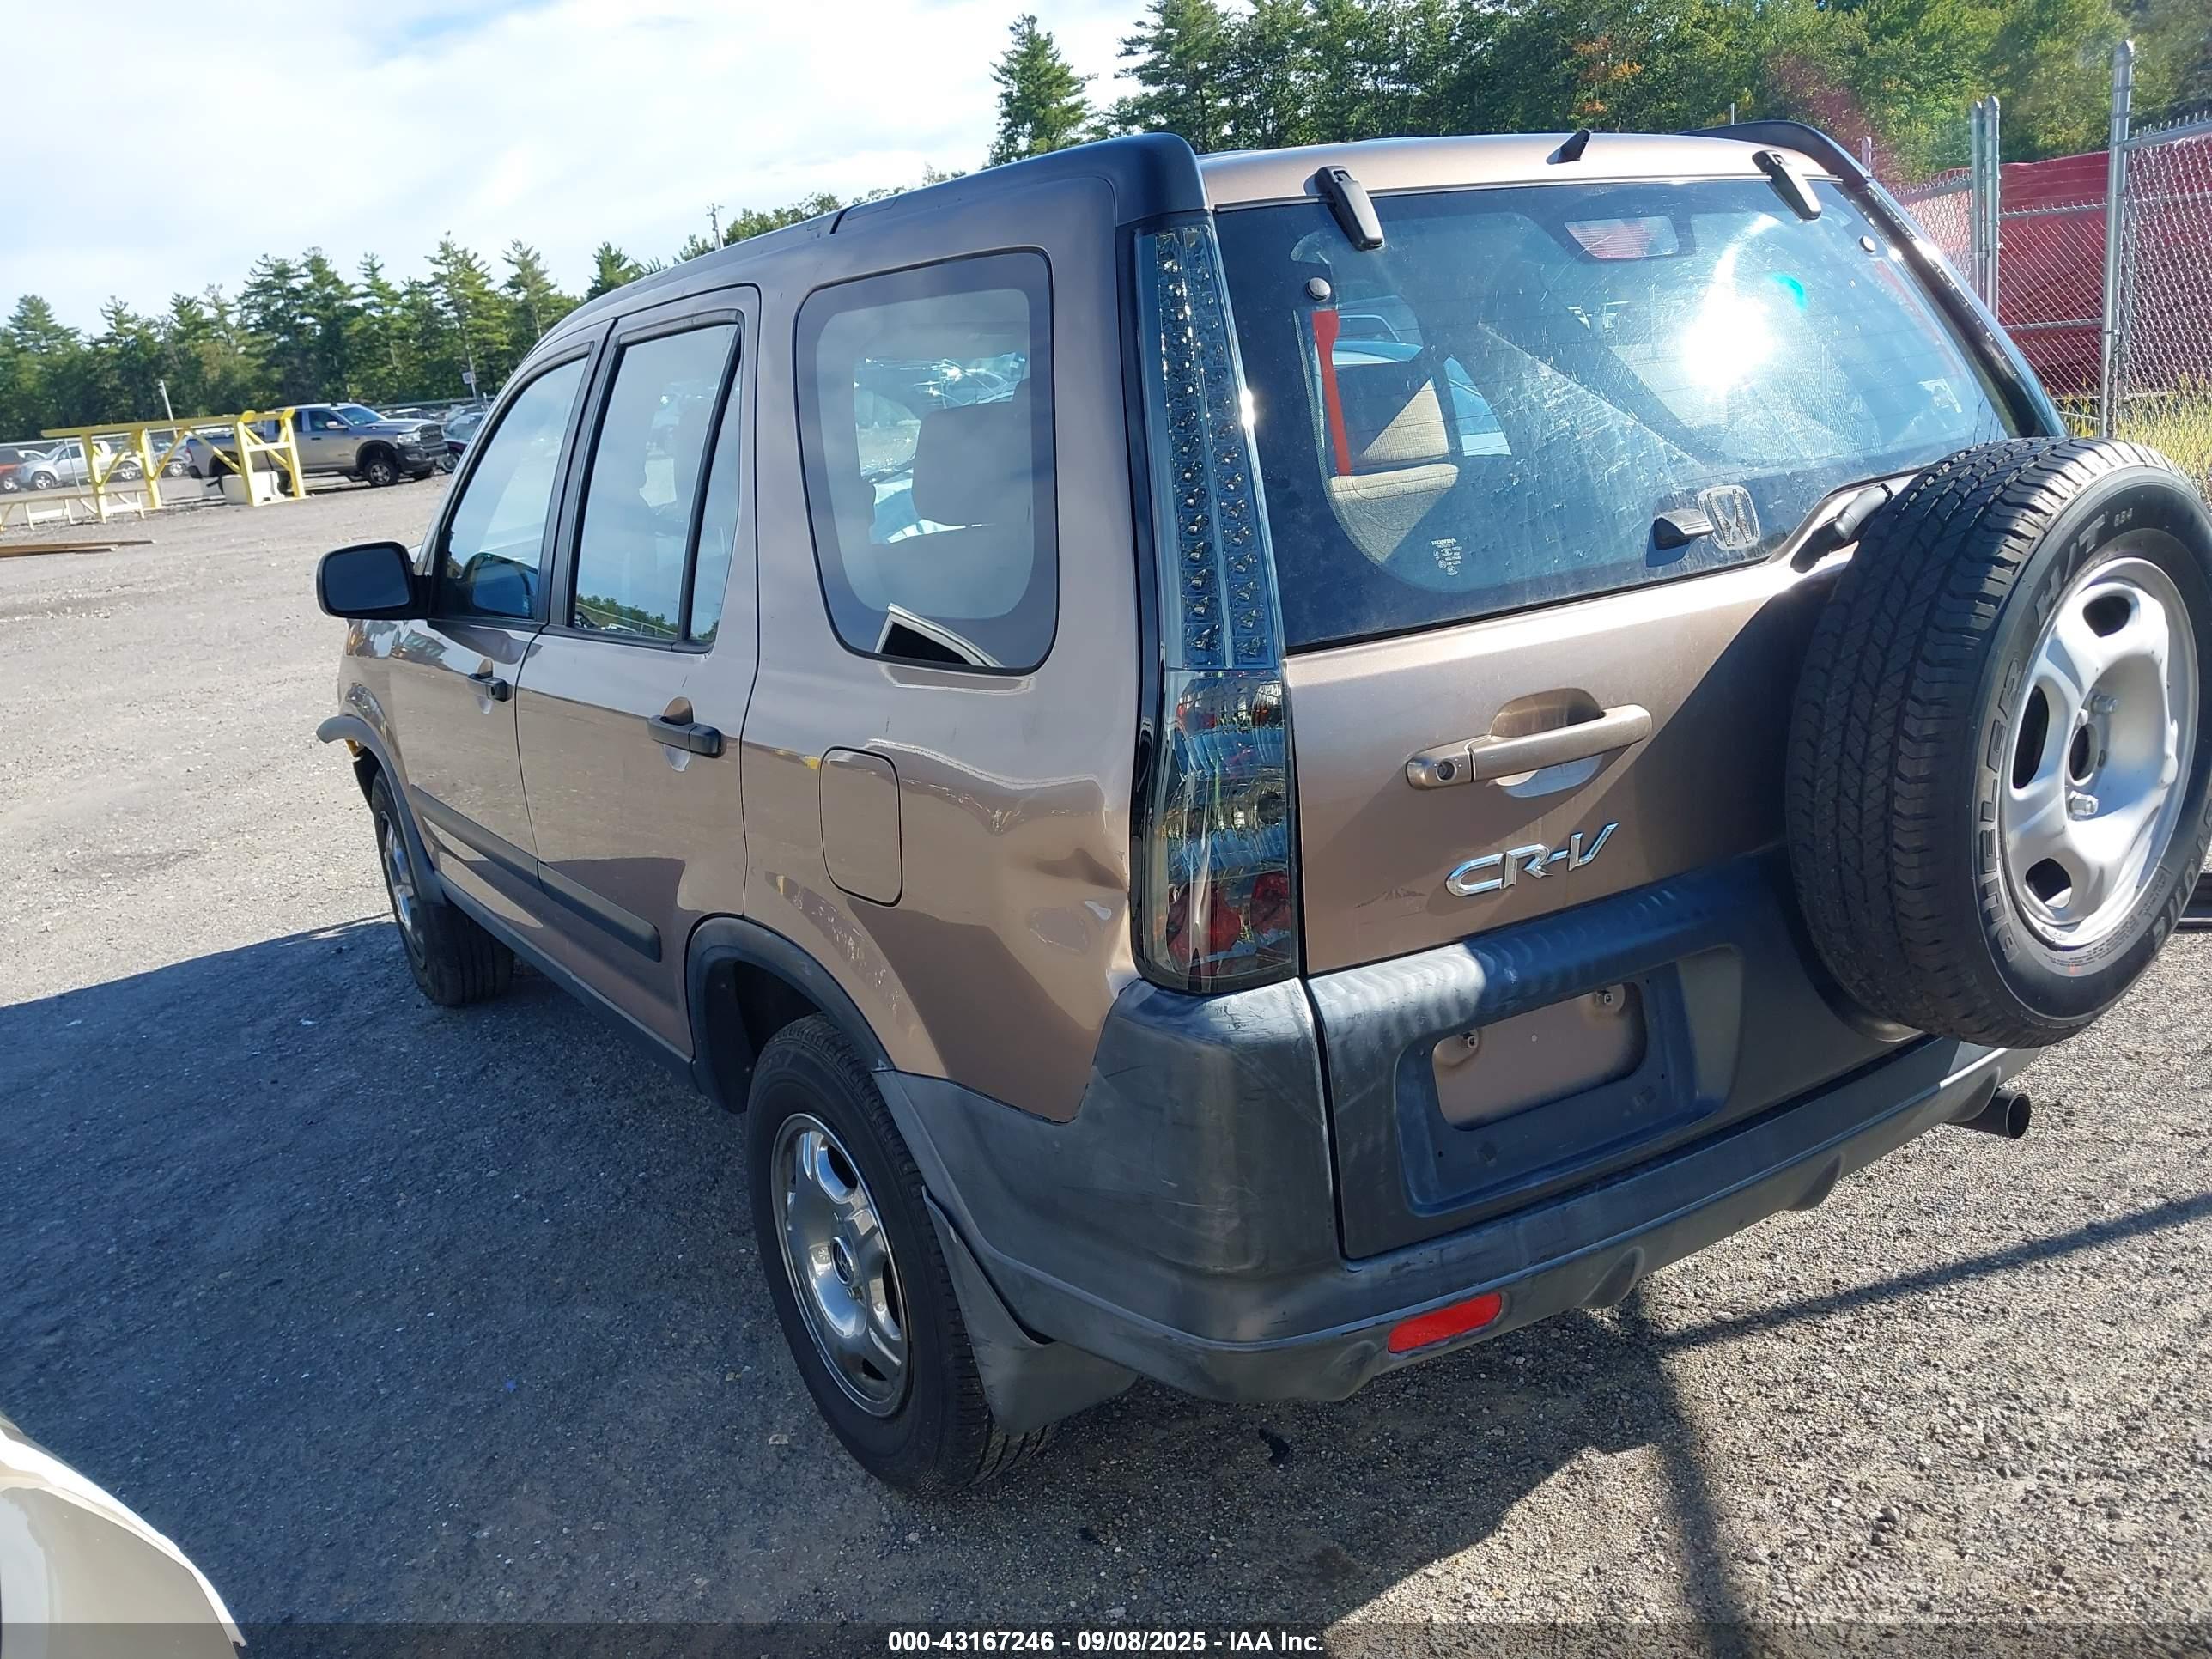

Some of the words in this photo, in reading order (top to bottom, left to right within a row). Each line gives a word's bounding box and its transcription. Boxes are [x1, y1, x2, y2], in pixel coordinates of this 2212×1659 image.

[1446, 822, 1620, 897] CR-V
[1978, 657, 2021, 963] DUELER
[2034, 514, 2106, 626] H/T
